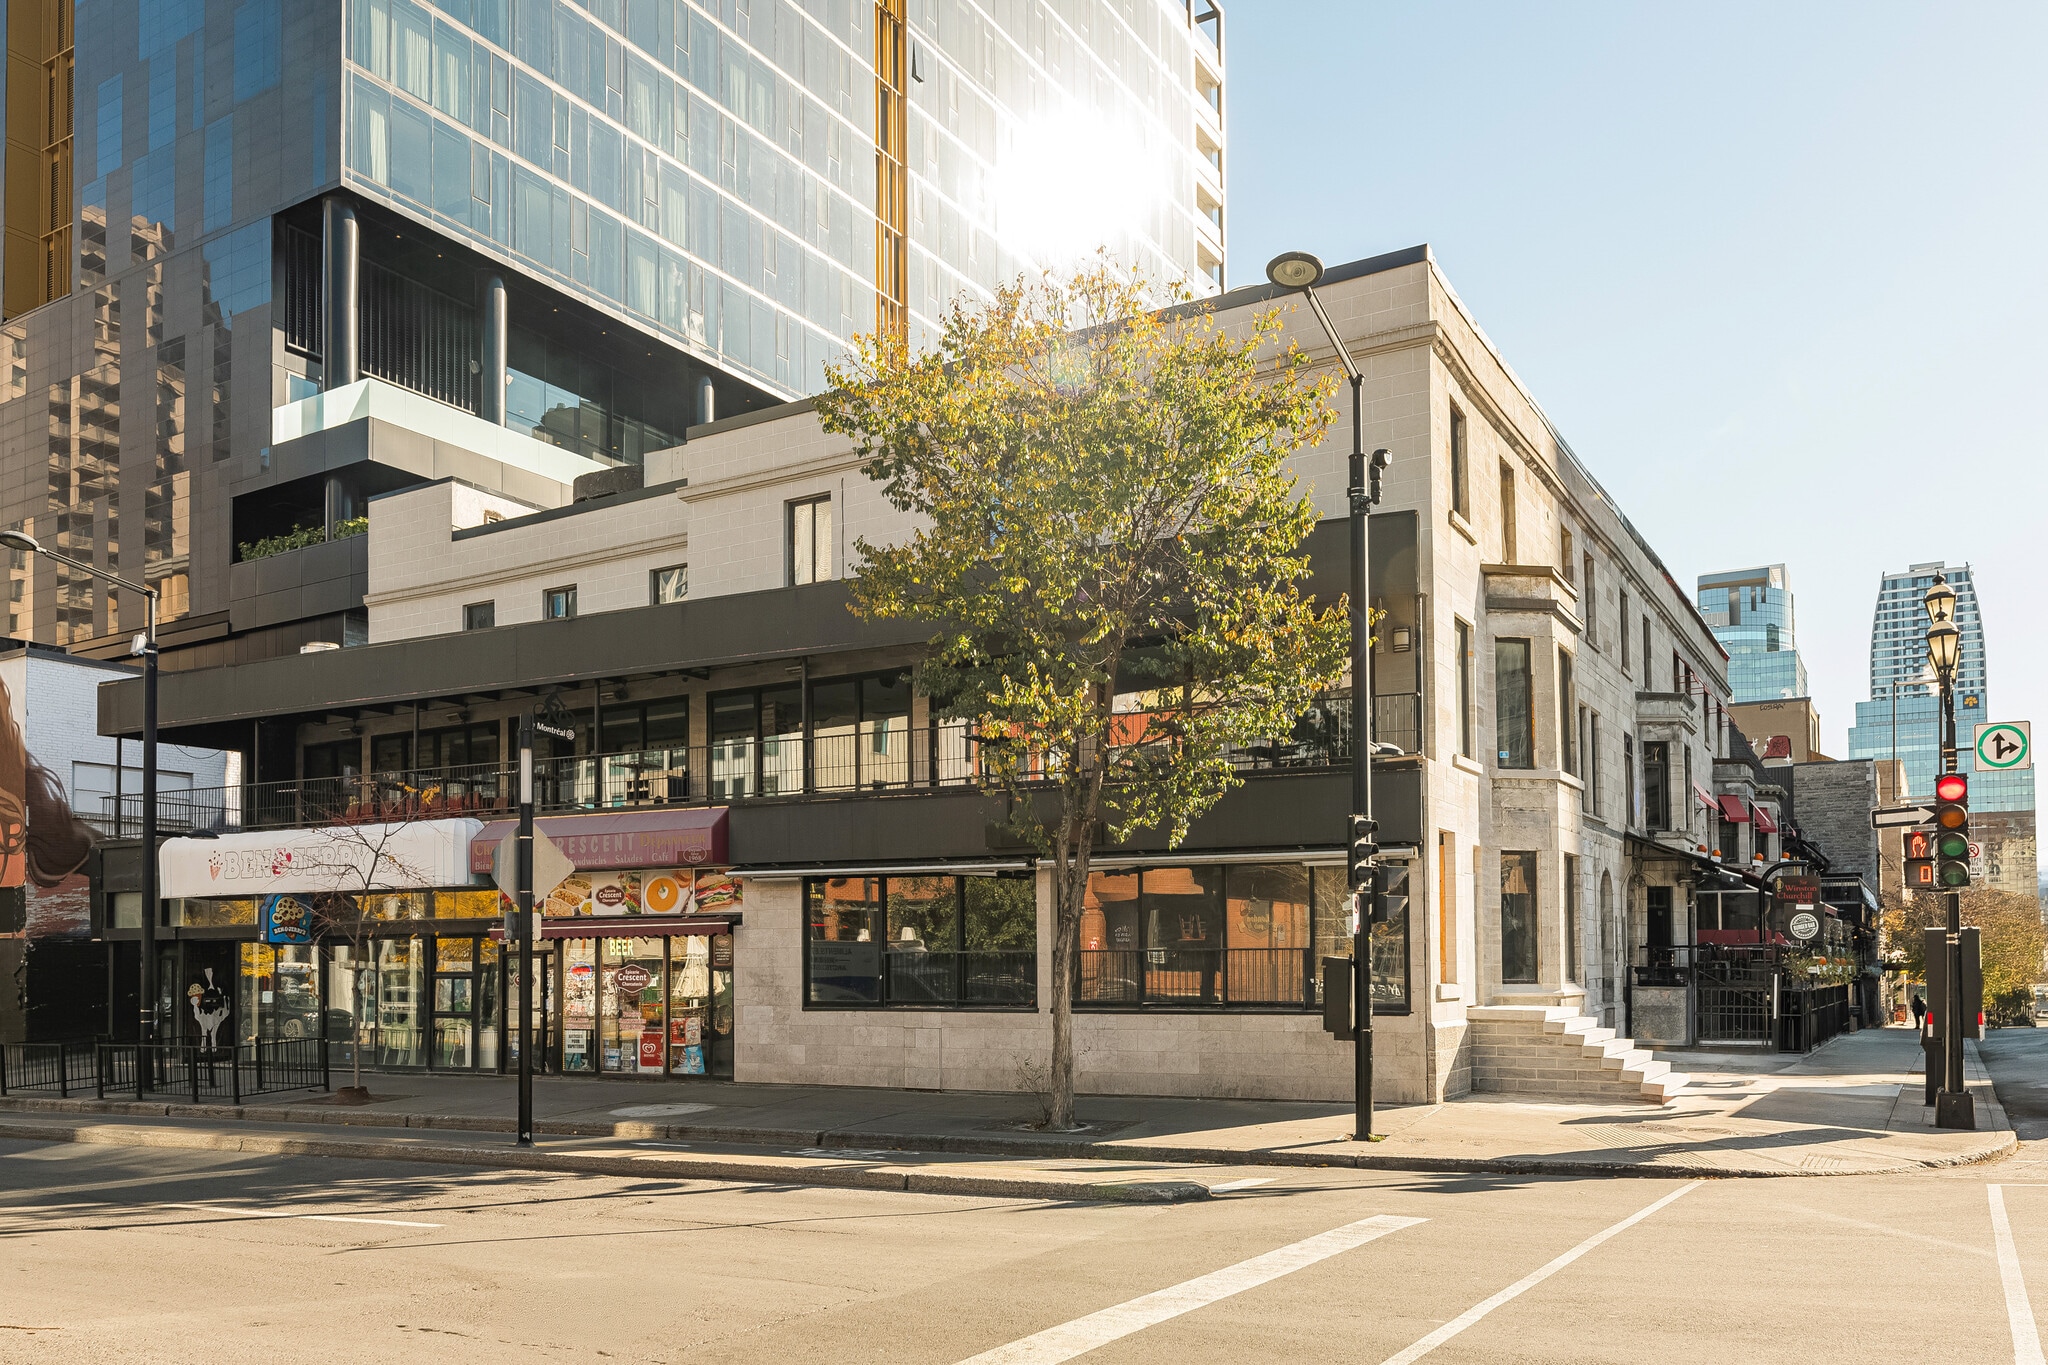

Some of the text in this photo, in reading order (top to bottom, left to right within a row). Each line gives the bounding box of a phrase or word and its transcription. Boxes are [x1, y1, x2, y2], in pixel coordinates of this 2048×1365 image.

[536, 721, 566, 737] Montréal
[556, 835, 634, 854] RESCENT
[224, 850, 272, 879] BEN
[609, 939, 634, 956] BEER
[617, 973, 647, 981] Crescent
